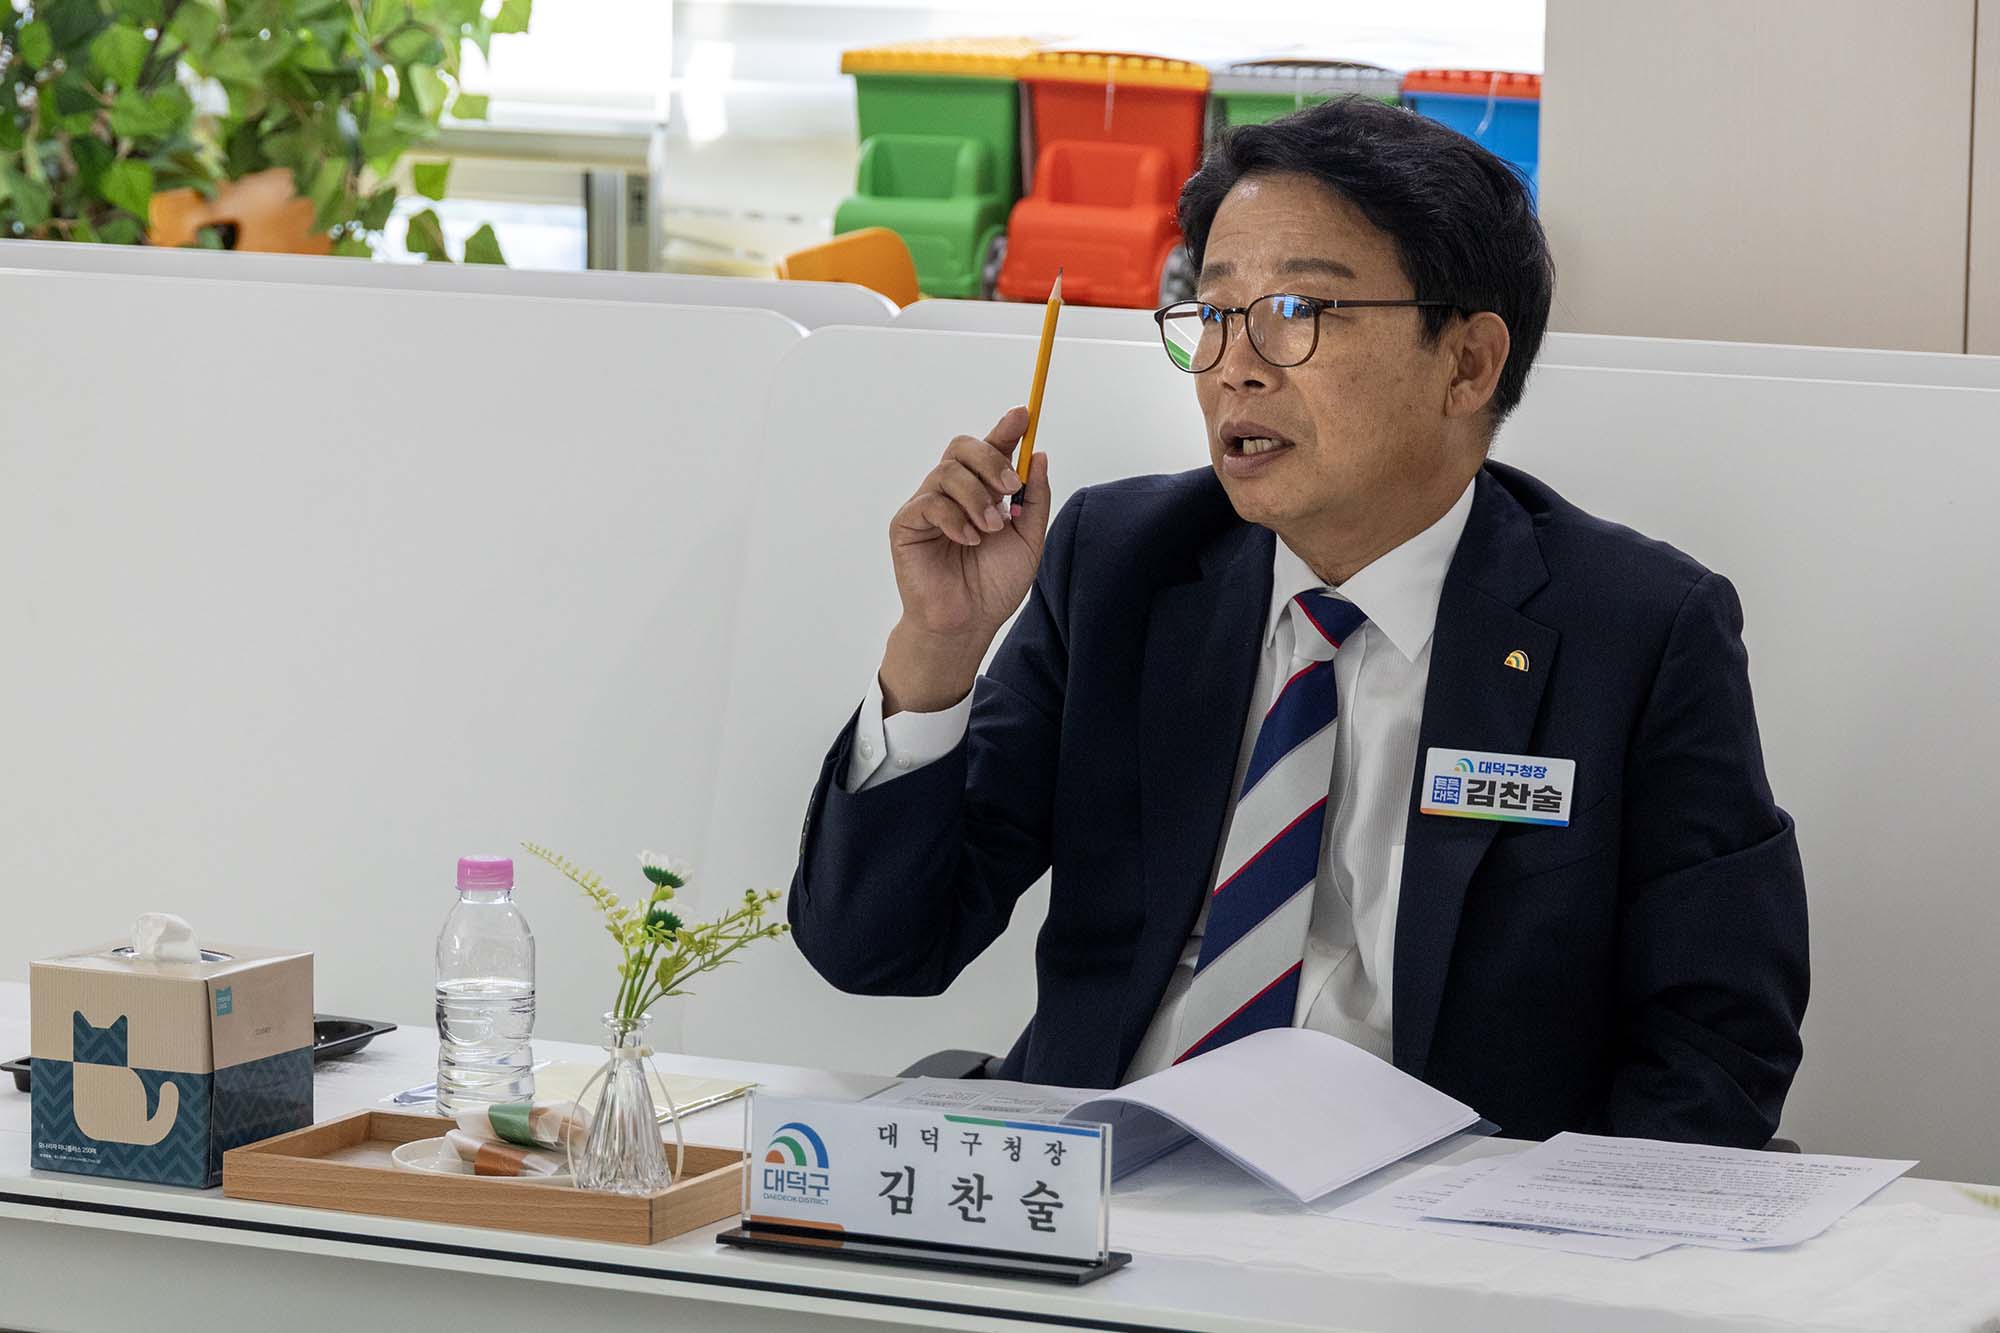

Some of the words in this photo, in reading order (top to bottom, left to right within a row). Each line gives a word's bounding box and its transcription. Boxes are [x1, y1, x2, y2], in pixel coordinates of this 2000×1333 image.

[1478, 761, 1548, 779] 대덕구청장
[1433, 790, 1459, 803] 대덕
[1466, 779, 1563, 813] 김찬술
[763, 1169, 830, 1198] 대덕구
